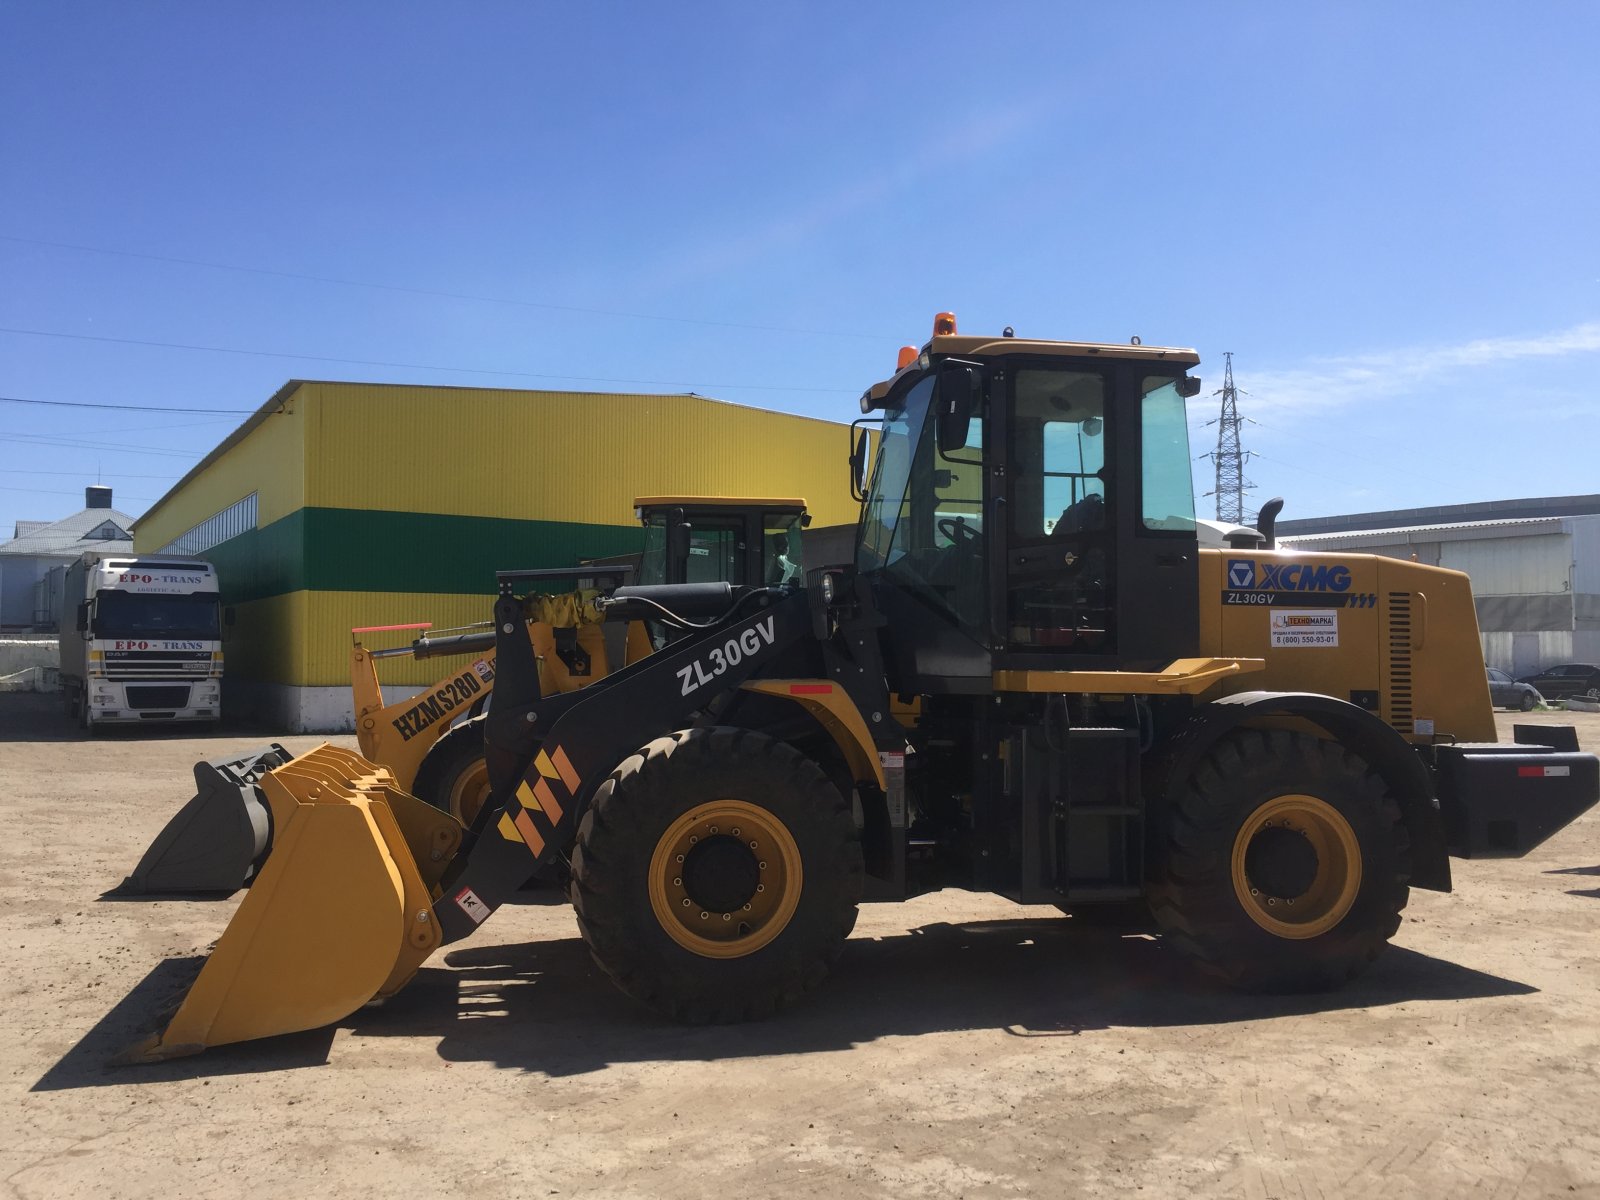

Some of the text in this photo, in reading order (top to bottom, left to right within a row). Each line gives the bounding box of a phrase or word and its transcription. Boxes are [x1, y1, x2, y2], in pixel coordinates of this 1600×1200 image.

[1256, 563, 1352, 592] XCMG
[1228, 593, 1275, 604] ZL30GV
[1289, 617, 1332, 625] ТЕХНОМАРКА
[1282, 636, 1300, 645] (800)
[676, 615, 775, 697] ZL30GV
[392, 672, 481, 742] HZMS28D
